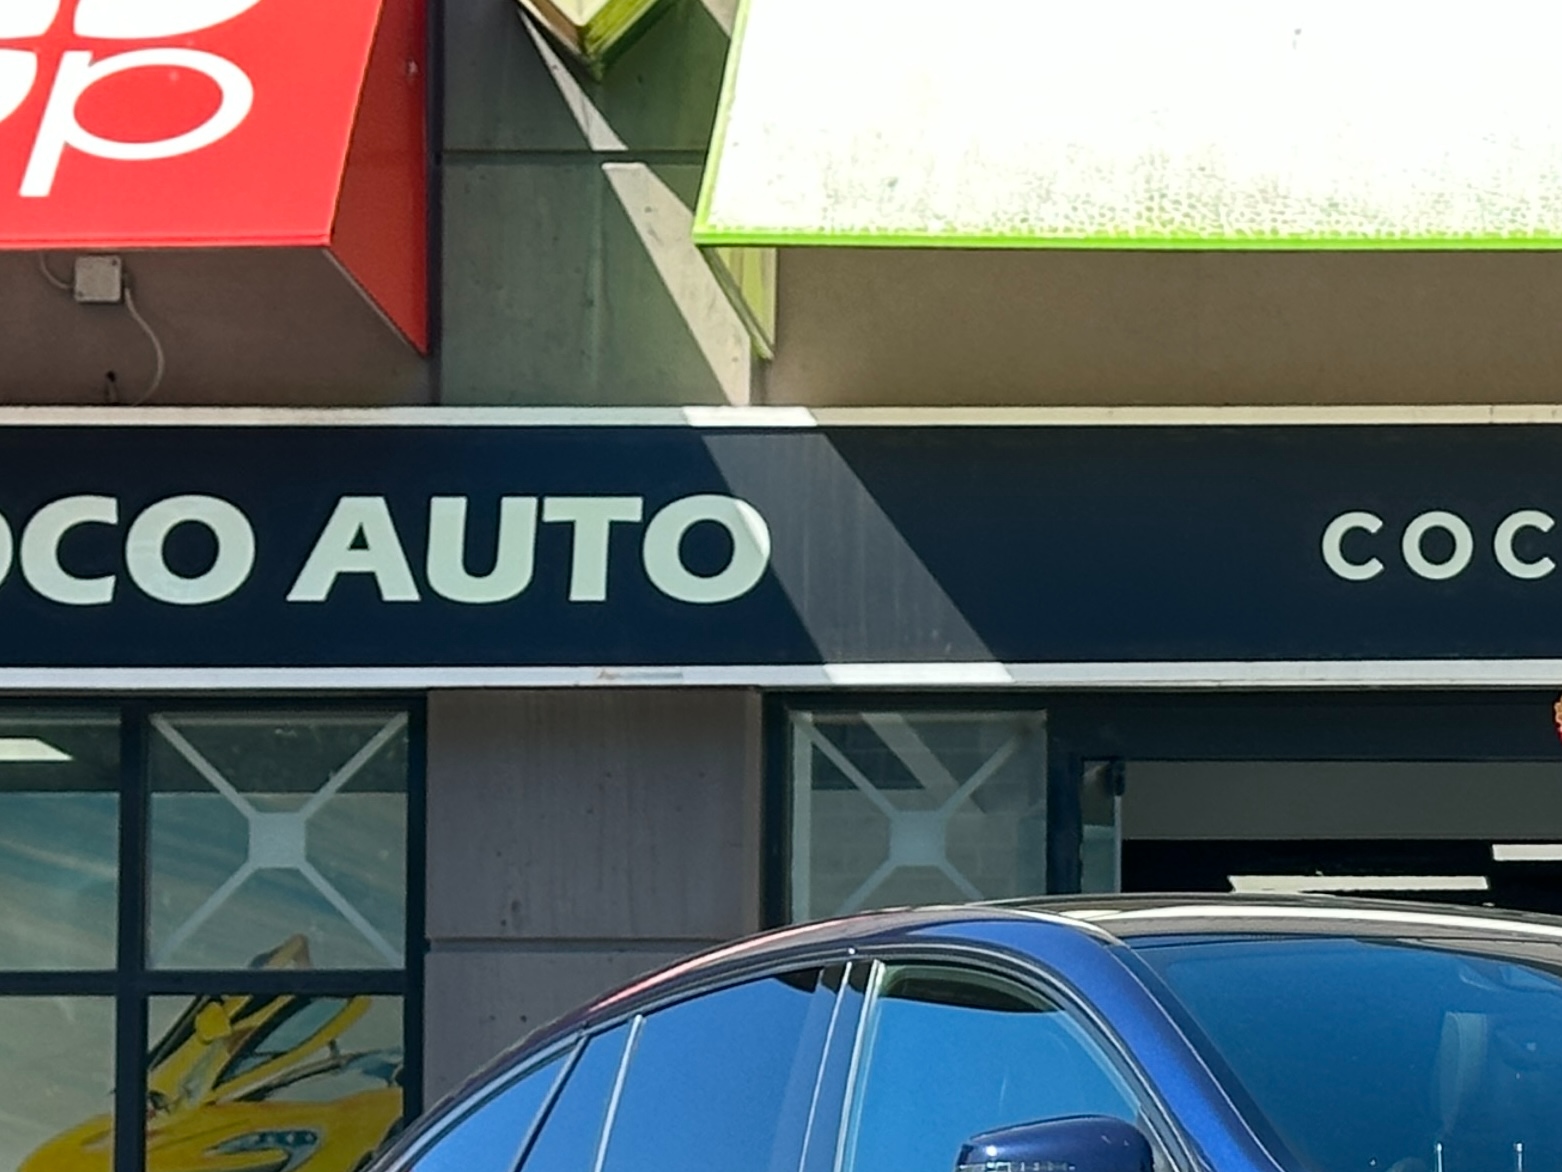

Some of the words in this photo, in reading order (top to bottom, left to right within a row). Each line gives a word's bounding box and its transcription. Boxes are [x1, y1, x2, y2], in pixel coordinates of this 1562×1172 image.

[0, 48, 254, 197] p
[0, 495, 256, 605] CO
[286, 494, 771, 604] AUTO
